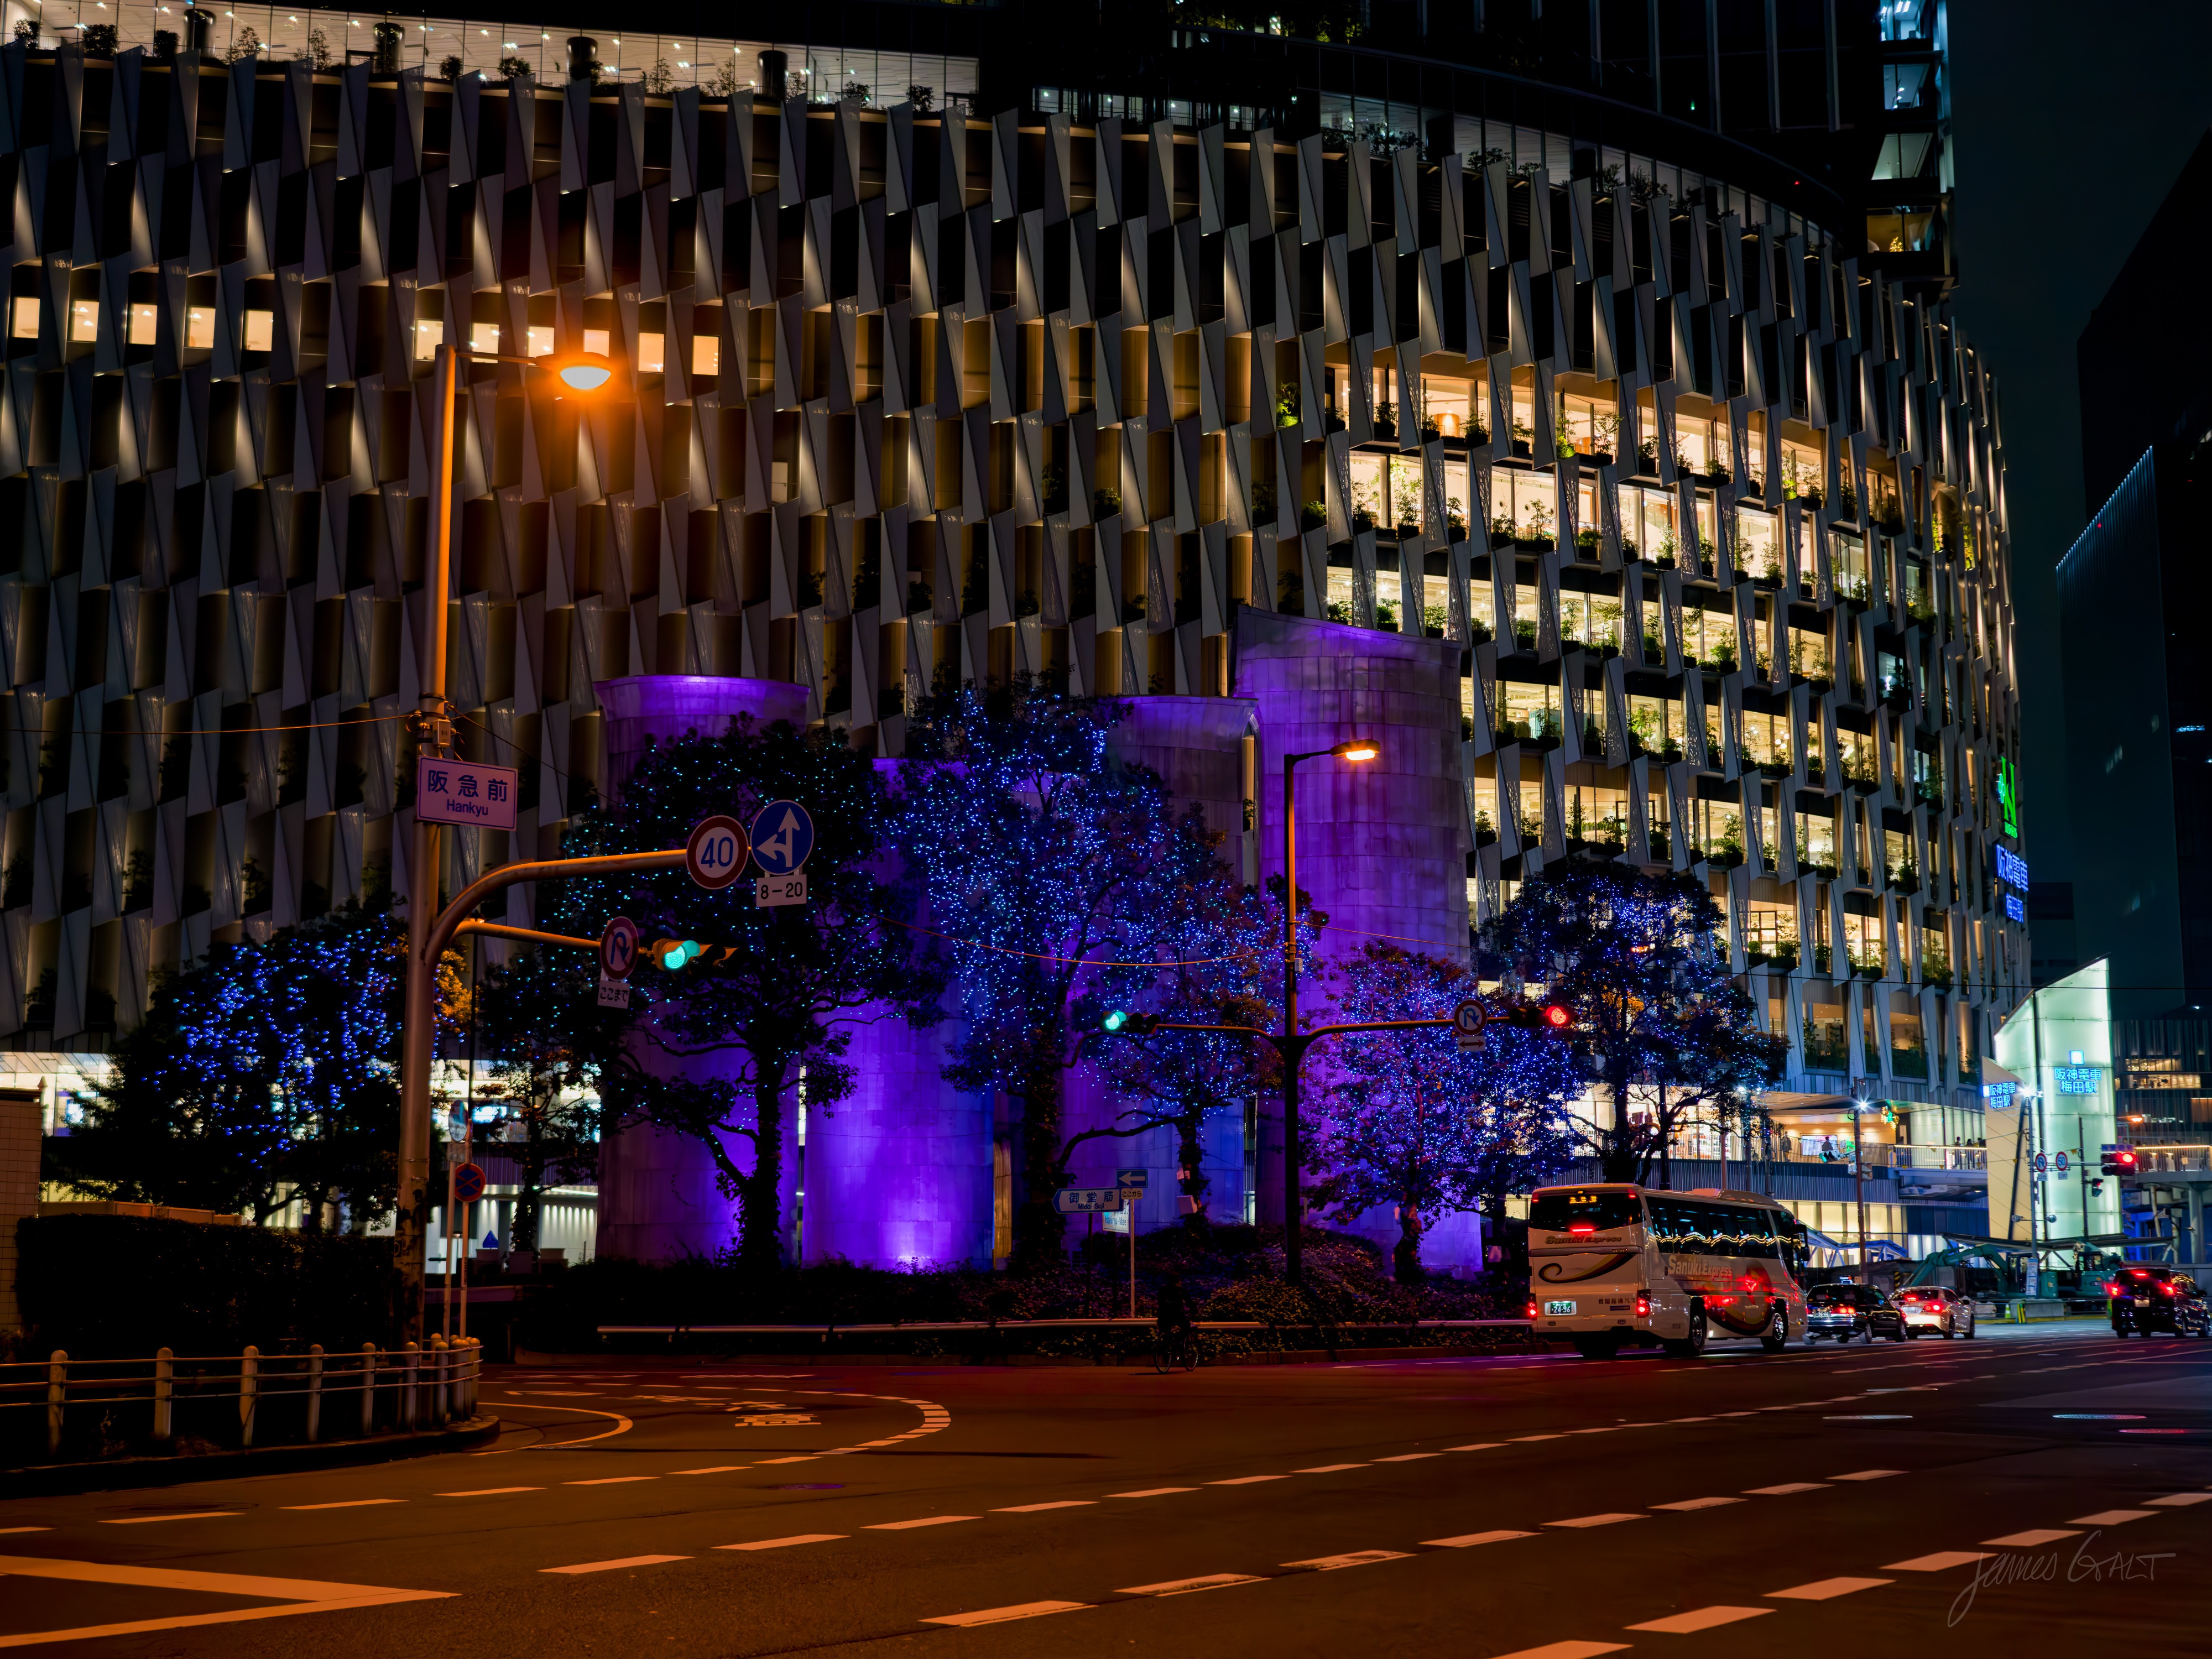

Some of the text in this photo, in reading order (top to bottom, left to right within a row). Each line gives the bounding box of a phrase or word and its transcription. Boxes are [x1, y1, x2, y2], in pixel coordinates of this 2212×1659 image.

[428, 770, 508, 802] 阪急前
[446, 799, 489, 817] Hankyu
[700, 836, 734, 868] 40
[1996, 844, 2029, 893] 阪神電車
[2005, 893, 2024, 924] 梅田駅
[599, 987, 629, 1003] ここまで
[2054, 1068, 2101, 1081] 阪神電車
[1989, 1082, 2016, 1097] 阪神電車
[2060, 1081, 2097, 1093] 梅田駅
[1990, 1094, 2011, 1109] 梅田駅
[2058, 1156, 2065, 1165] 50
[1069, 1191, 1113, 1203] 御堂筋
[1545, 1235, 1584, 1244] Sanuki
[1668, 1254, 1733, 1277] Sanuki Express
